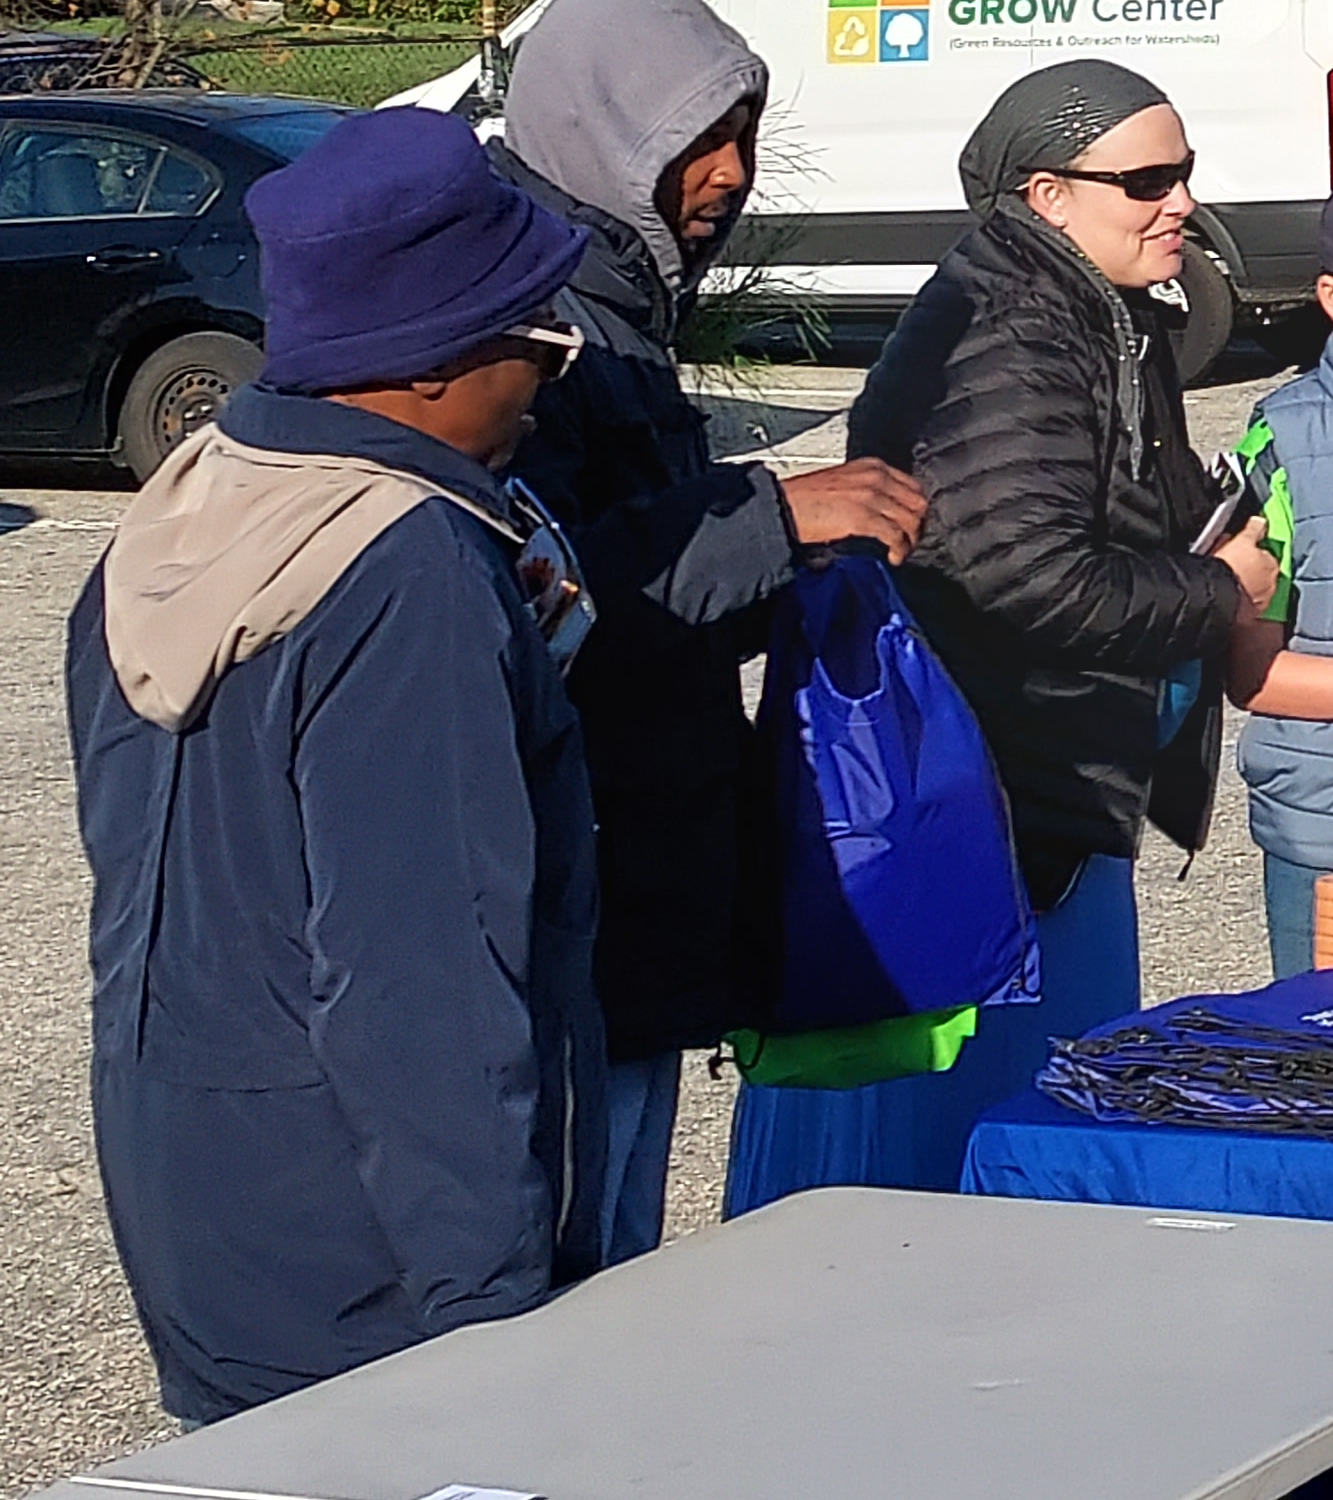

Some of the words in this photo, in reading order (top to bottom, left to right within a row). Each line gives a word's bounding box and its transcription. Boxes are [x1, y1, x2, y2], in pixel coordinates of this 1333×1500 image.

[949, 37, 989, 50] (Green
[992, 36, 1052, 47] Resources
[1055, 35, 1064, 47] &
[1067, 34, 1123, 47] Outreach
[1125, 34, 1143, 46] for
[1145, 33, 1221, 46] Watersheds)
